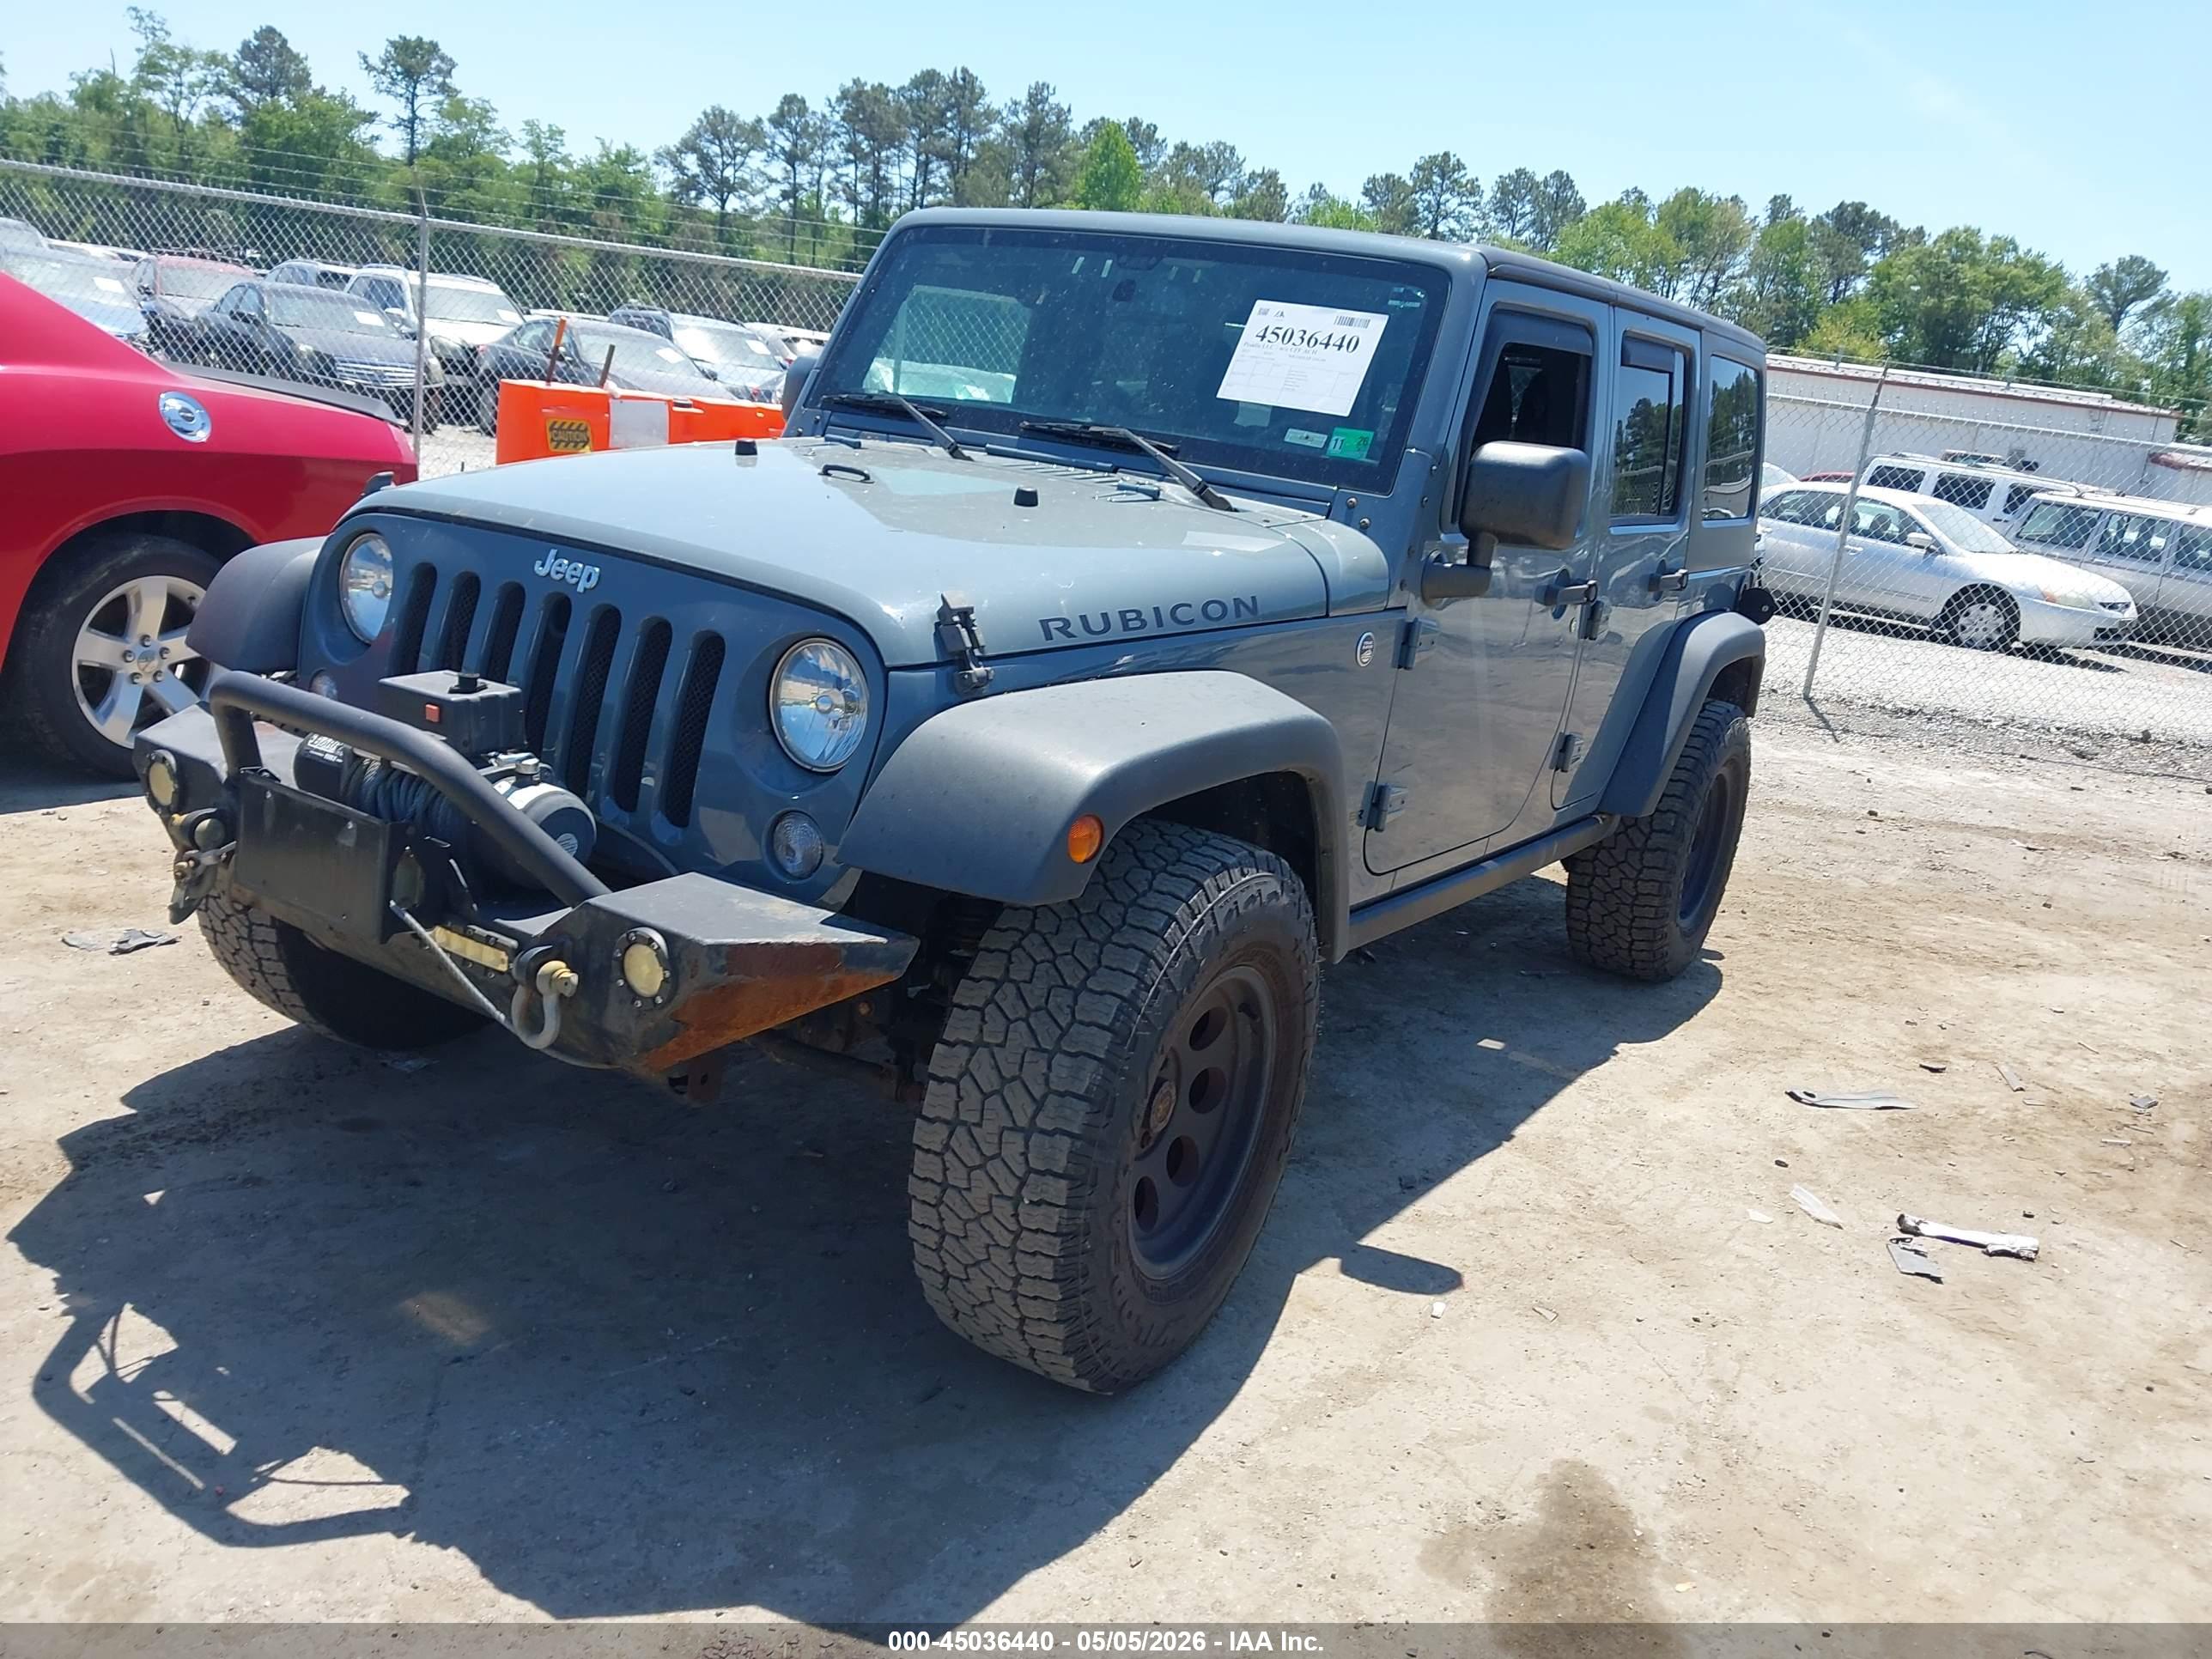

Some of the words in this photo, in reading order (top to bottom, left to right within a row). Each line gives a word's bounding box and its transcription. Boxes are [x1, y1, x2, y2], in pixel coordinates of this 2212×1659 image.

[1255, 325, 1359, 353] 45036440
[551, 431, 588, 441] CAUTION
[1332, 437, 1345, 451] 11
[534, 549, 600, 593] Jeep
[1038, 595, 1259, 641] RUBICON
